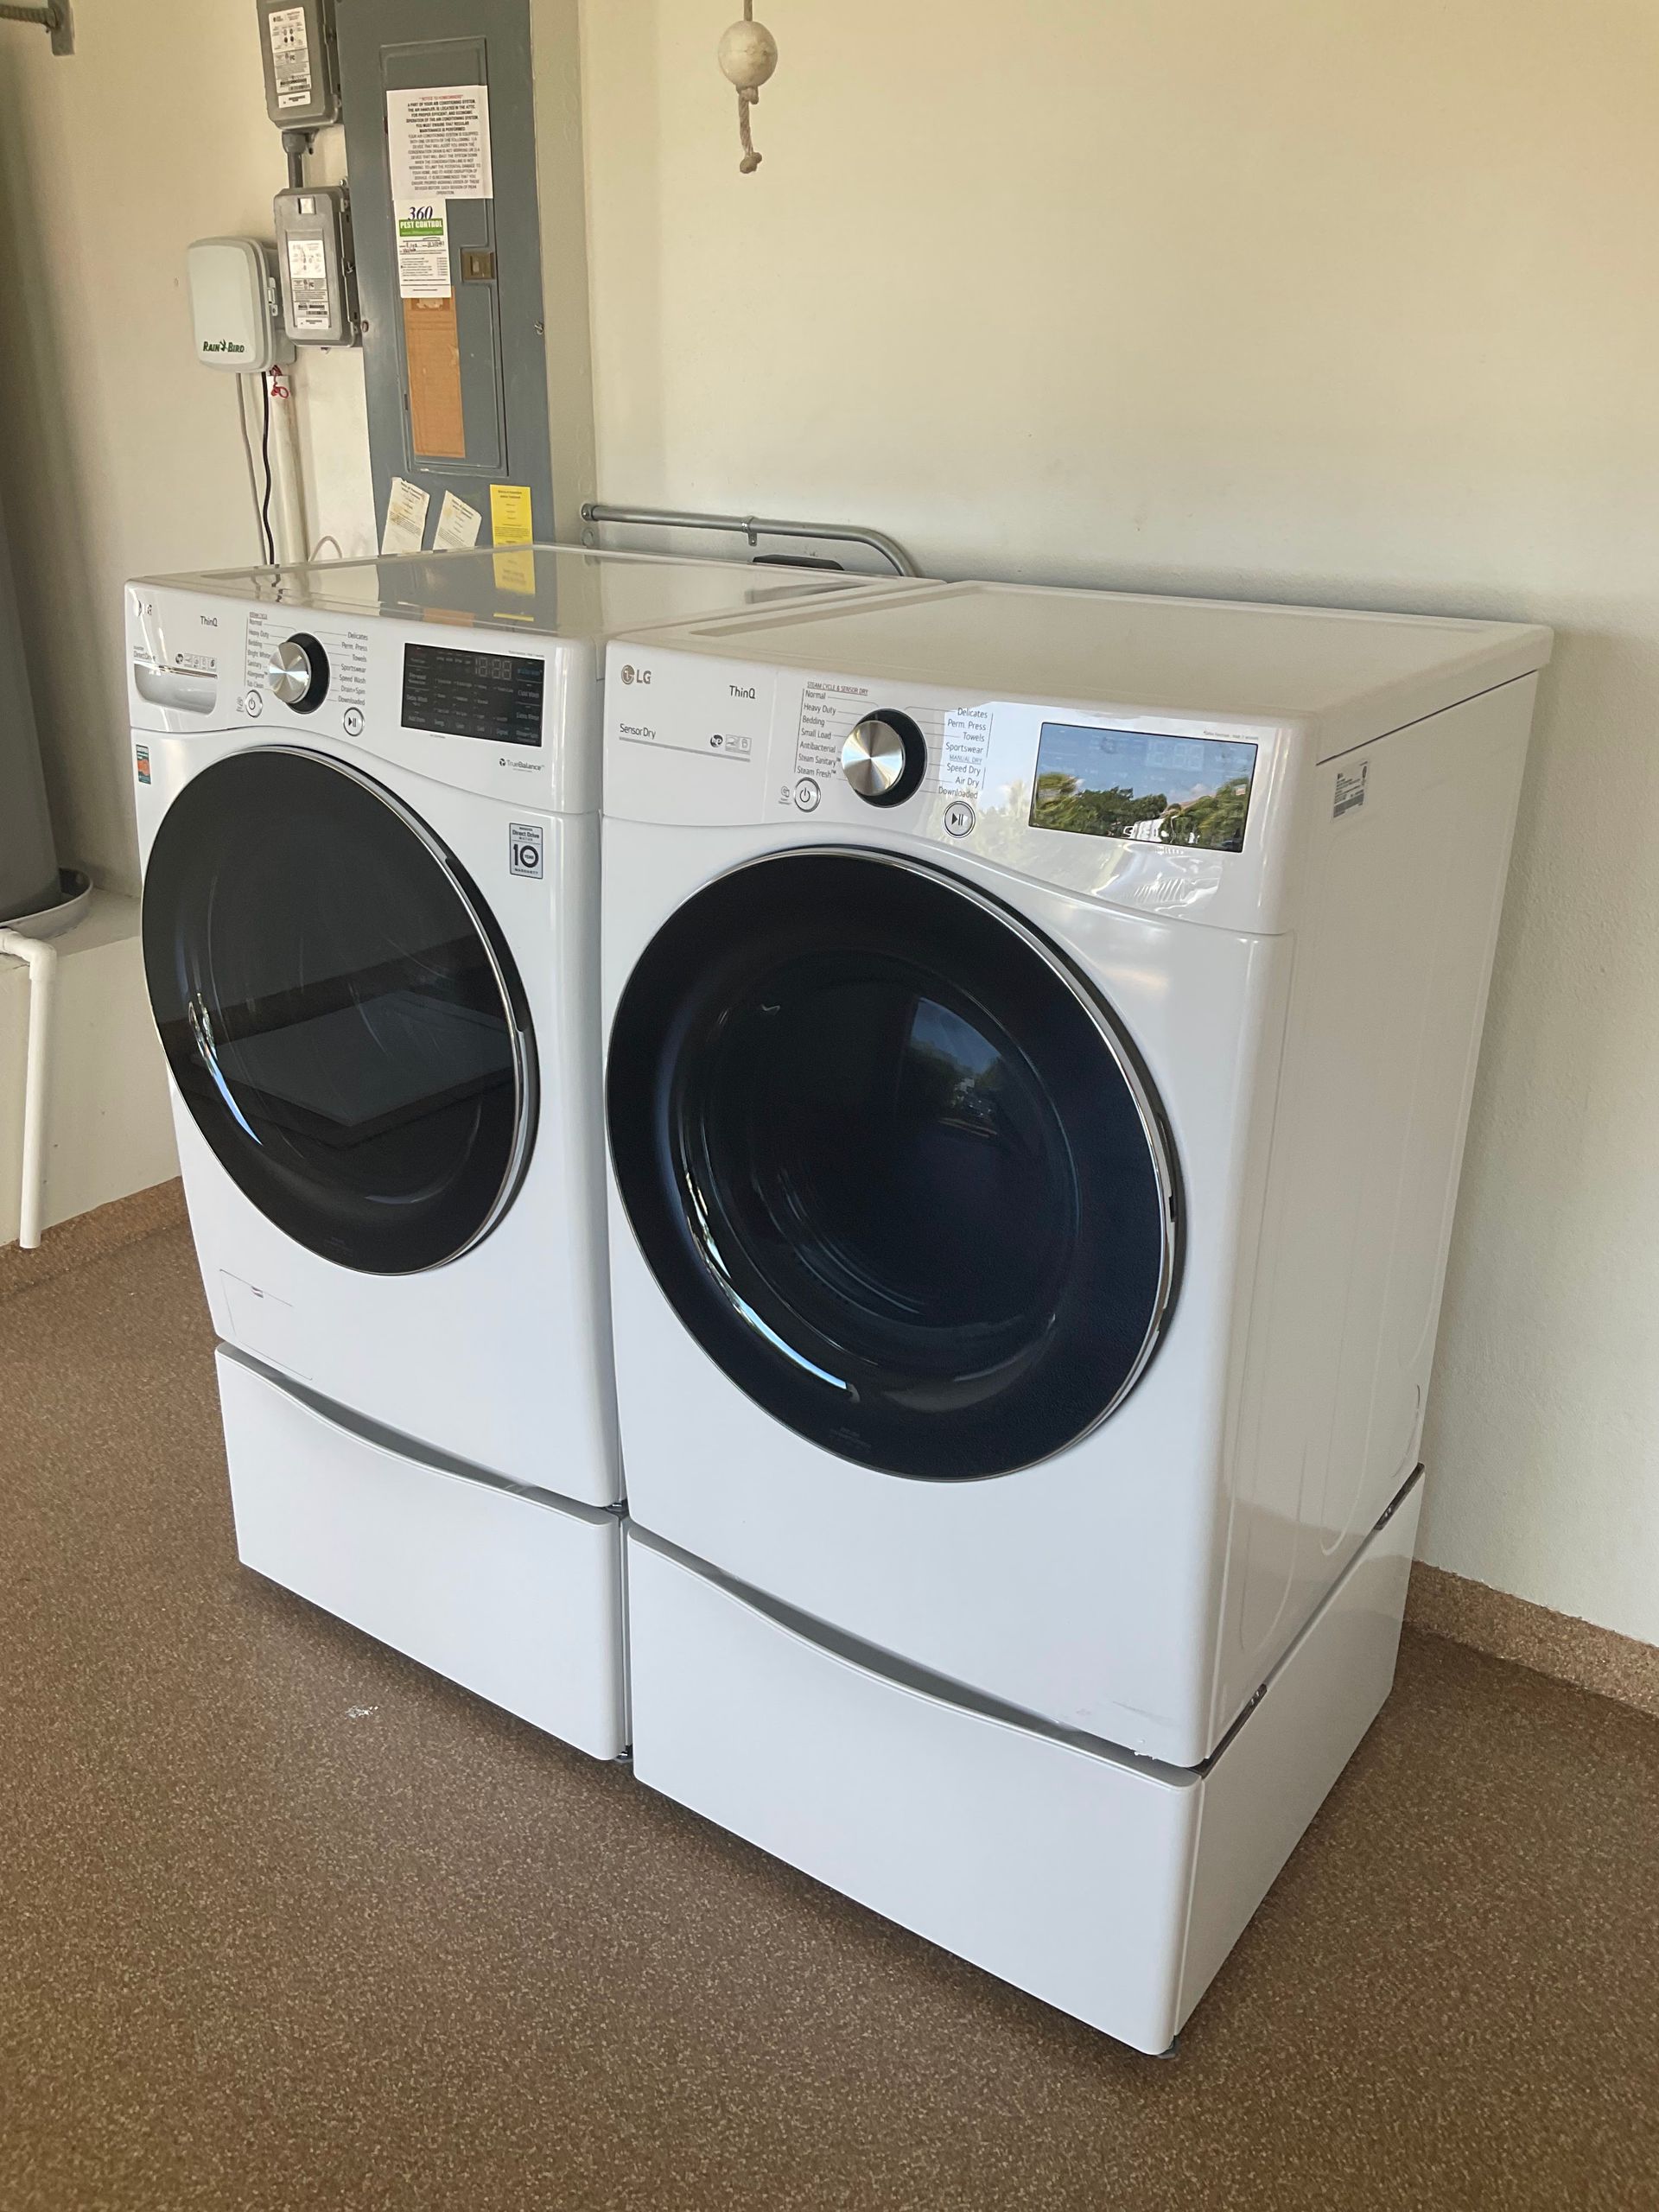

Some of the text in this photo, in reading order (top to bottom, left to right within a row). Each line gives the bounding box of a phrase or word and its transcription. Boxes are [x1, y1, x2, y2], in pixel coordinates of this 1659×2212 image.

[408, 206, 433, 220] 360
[203, 341, 245, 353] RAIN BIRD
[200, 615, 218, 627] ThinQ
[347, 632, 368, 640] Delicates
[355, 643, 367, 652] Press
[353, 654, 366, 663] Towels
[340, 664, 366, 673] Sportswear
[340, 674, 353, 683] Speed
[636, 669, 652, 684] LG
[729, 685, 756, 699] ThinQ
[805, 690, 826, 699] Normal
[339, 696, 365, 706] Downloaded
[804, 703, 836, 715] Heavy Duty
[957, 707, 988, 719] Delicates
[803, 715, 825, 728] Bedding
[947, 719, 986, 731] Perm. Press
[802, 728, 831, 740] Small Load
[963, 732, 985, 741] Towels
[800, 741, 836, 753] Antibacterial
[946, 742, 983, 753] Sportswear
[797, 766, 814, 776] Steam
[947, 763, 981, 776] Speed Dry
[968, 779, 980, 789] Dry
[938, 786, 978, 798] Downloaded
[513, 844, 539, 868] 10
